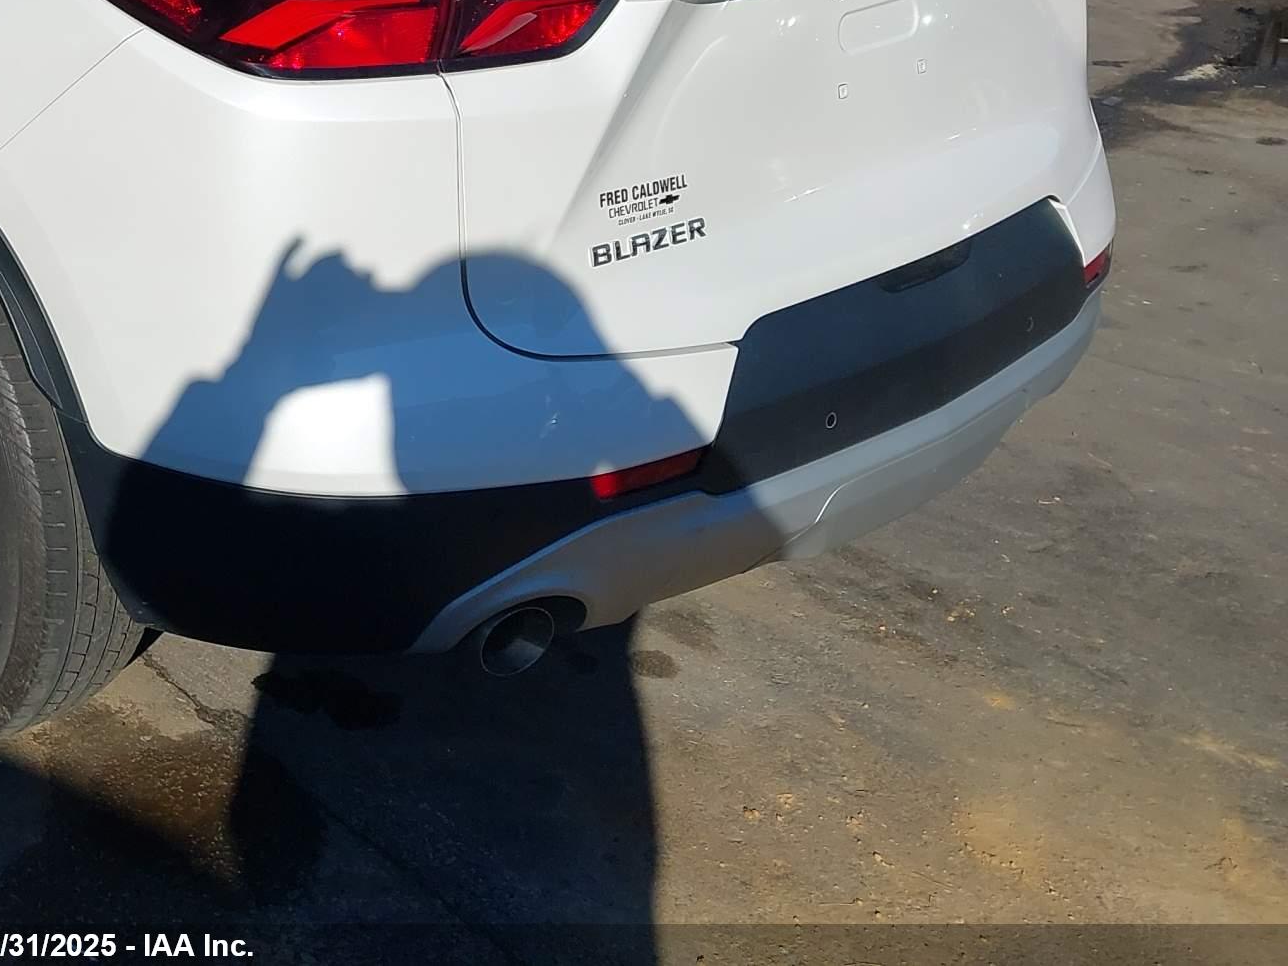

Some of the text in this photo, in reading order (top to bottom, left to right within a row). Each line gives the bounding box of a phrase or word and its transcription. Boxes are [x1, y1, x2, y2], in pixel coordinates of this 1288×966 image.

[600, 174, 688, 208] FRED CALDWELL
[609, 197, 659, 218] CHEVROLET
[591, 217, 707, 267] BLAZER
